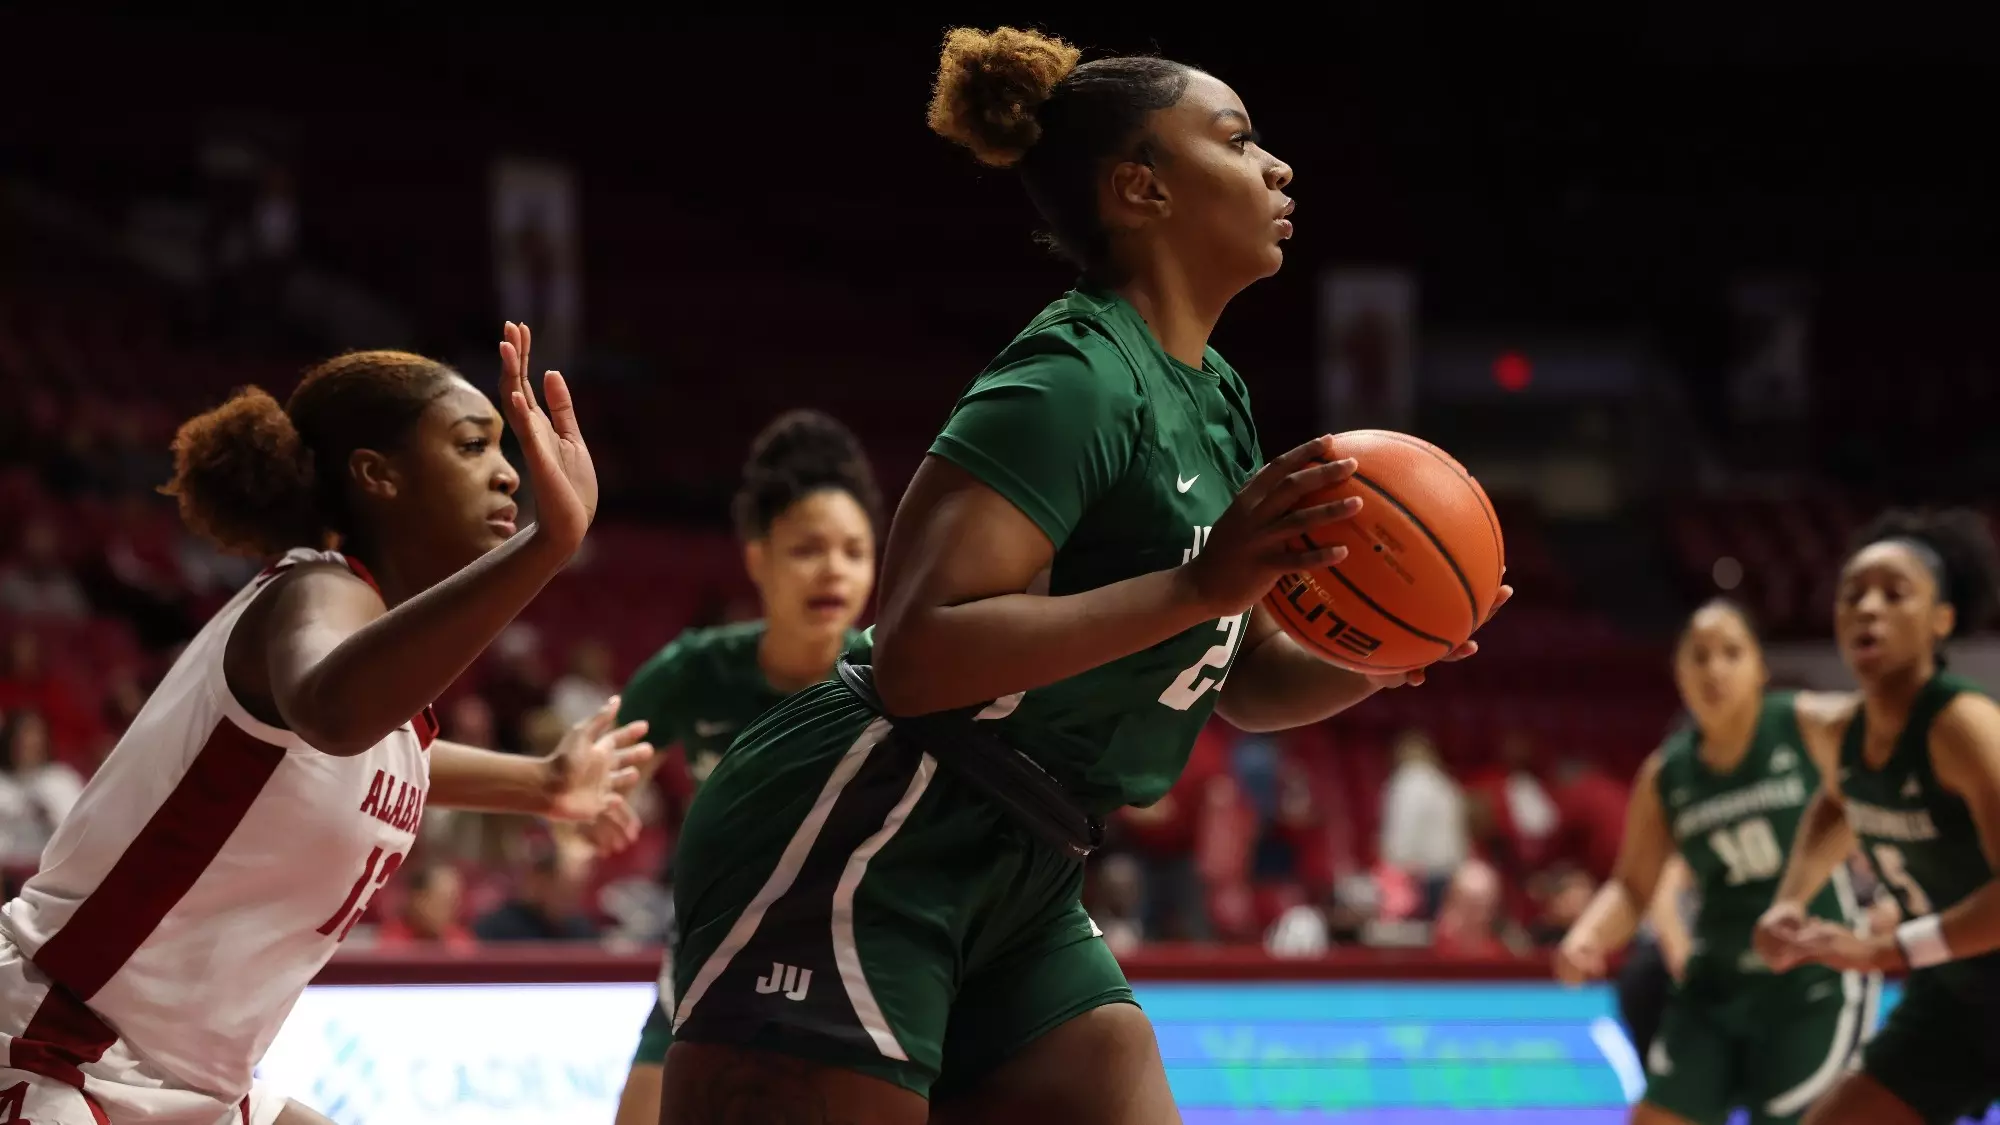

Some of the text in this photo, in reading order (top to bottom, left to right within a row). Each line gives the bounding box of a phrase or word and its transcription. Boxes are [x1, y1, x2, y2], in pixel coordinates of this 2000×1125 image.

[1277, 573, 1382, 658] ELITE
[1158, 612, 1244, 711] 2
[1709, 818, 1782, 885] 10
[755, 962, 813, 1001] JU
